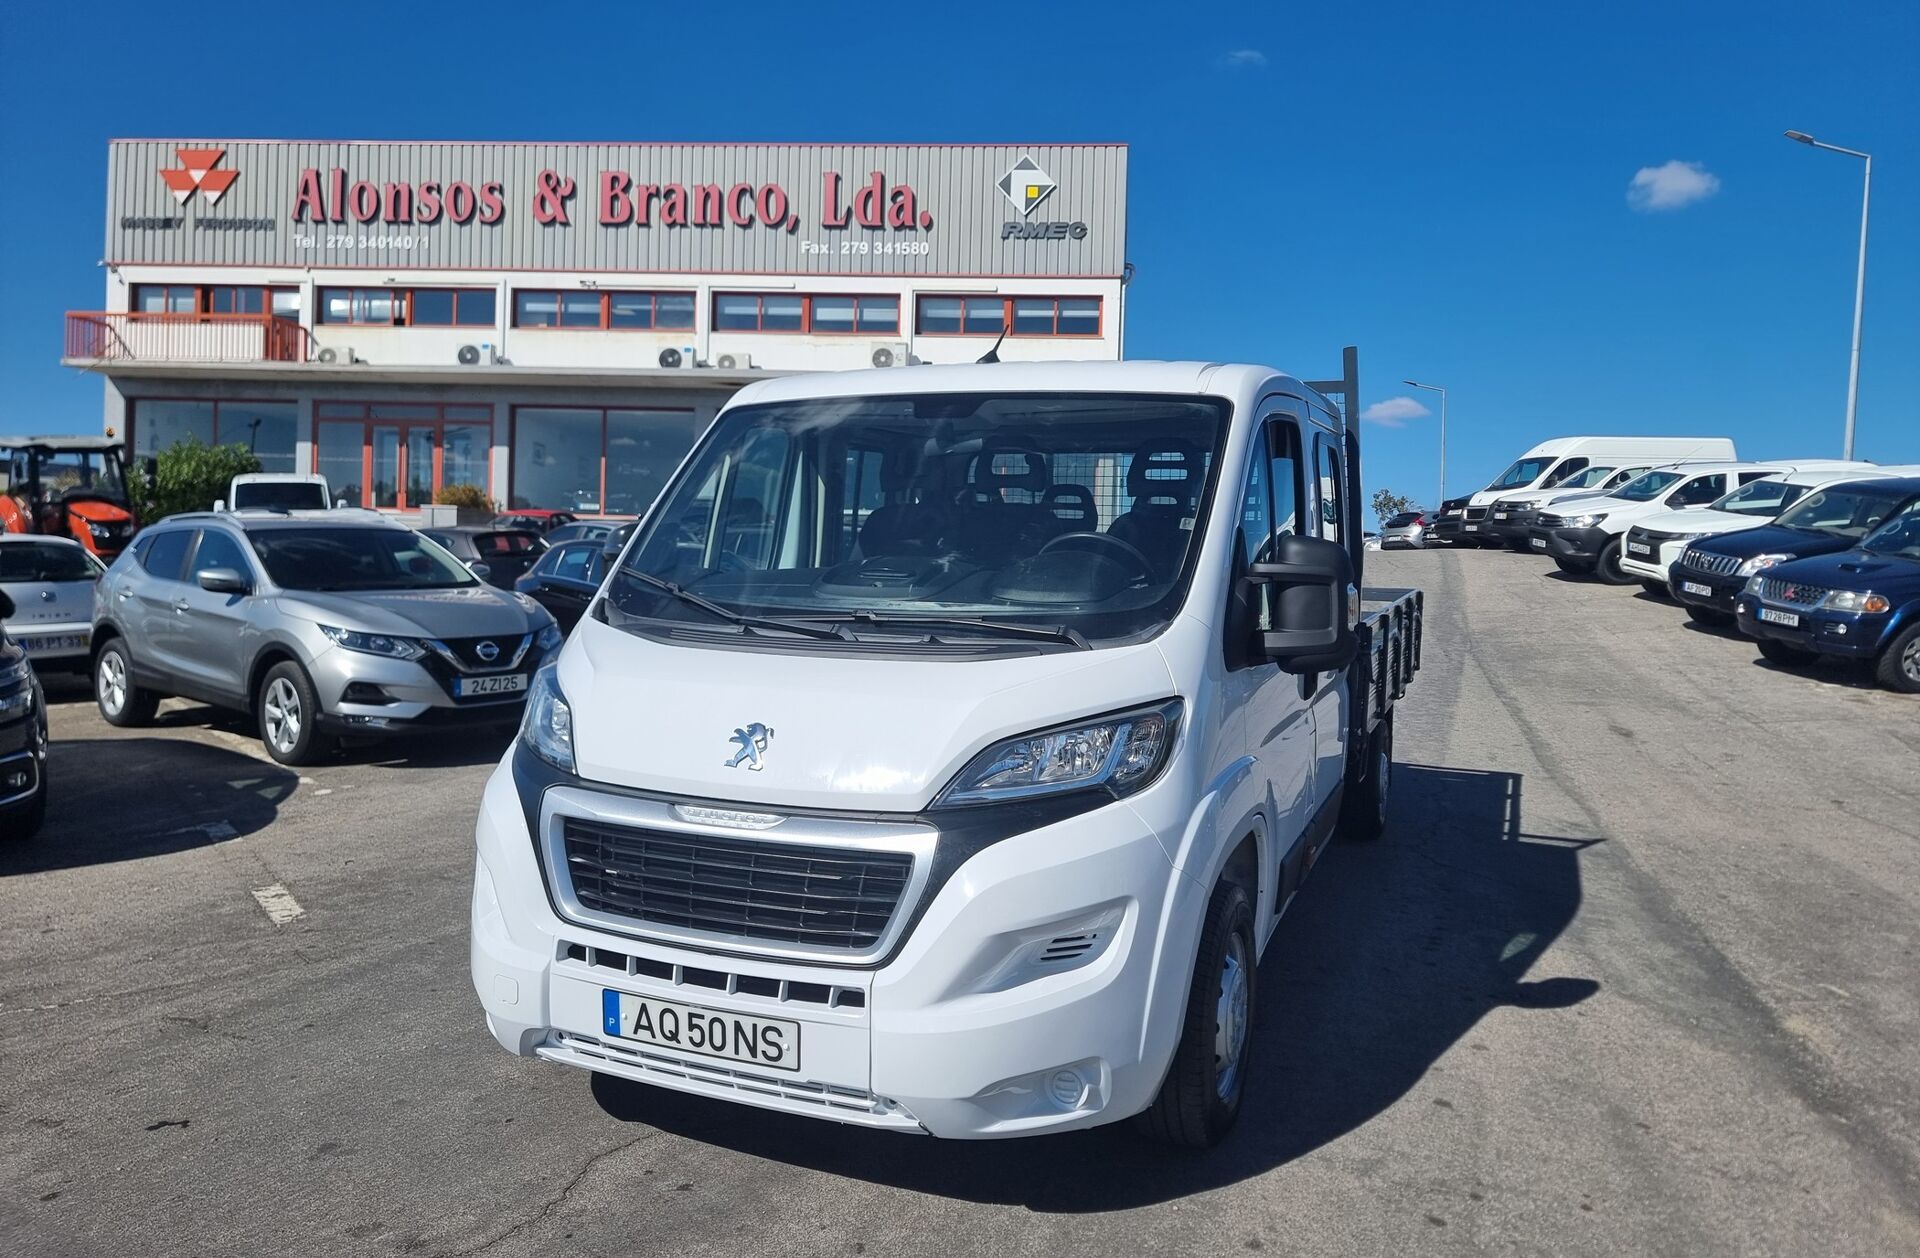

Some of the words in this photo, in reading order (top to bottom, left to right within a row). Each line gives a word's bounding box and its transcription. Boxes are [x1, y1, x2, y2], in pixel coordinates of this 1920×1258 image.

[291, 167, 504, 224] Alonsos
[532, 169, 576, 226] &
[599, 170, 799, 234] Branco,
[822, 171, 933, 231] Lda.
[1001, 221, 1088, 240] RMEC
[294, 233, 320, 249] Tel.
[326, 234, 354, 249] 279
[358, 234, 429, 250] 340140/1
[800, 240, 834, 255] Fax.
[841, 241, 869, 255] 279
[873, 241, 930, 256] 341580
[686, 807, 769, 823] PEUGEOT
